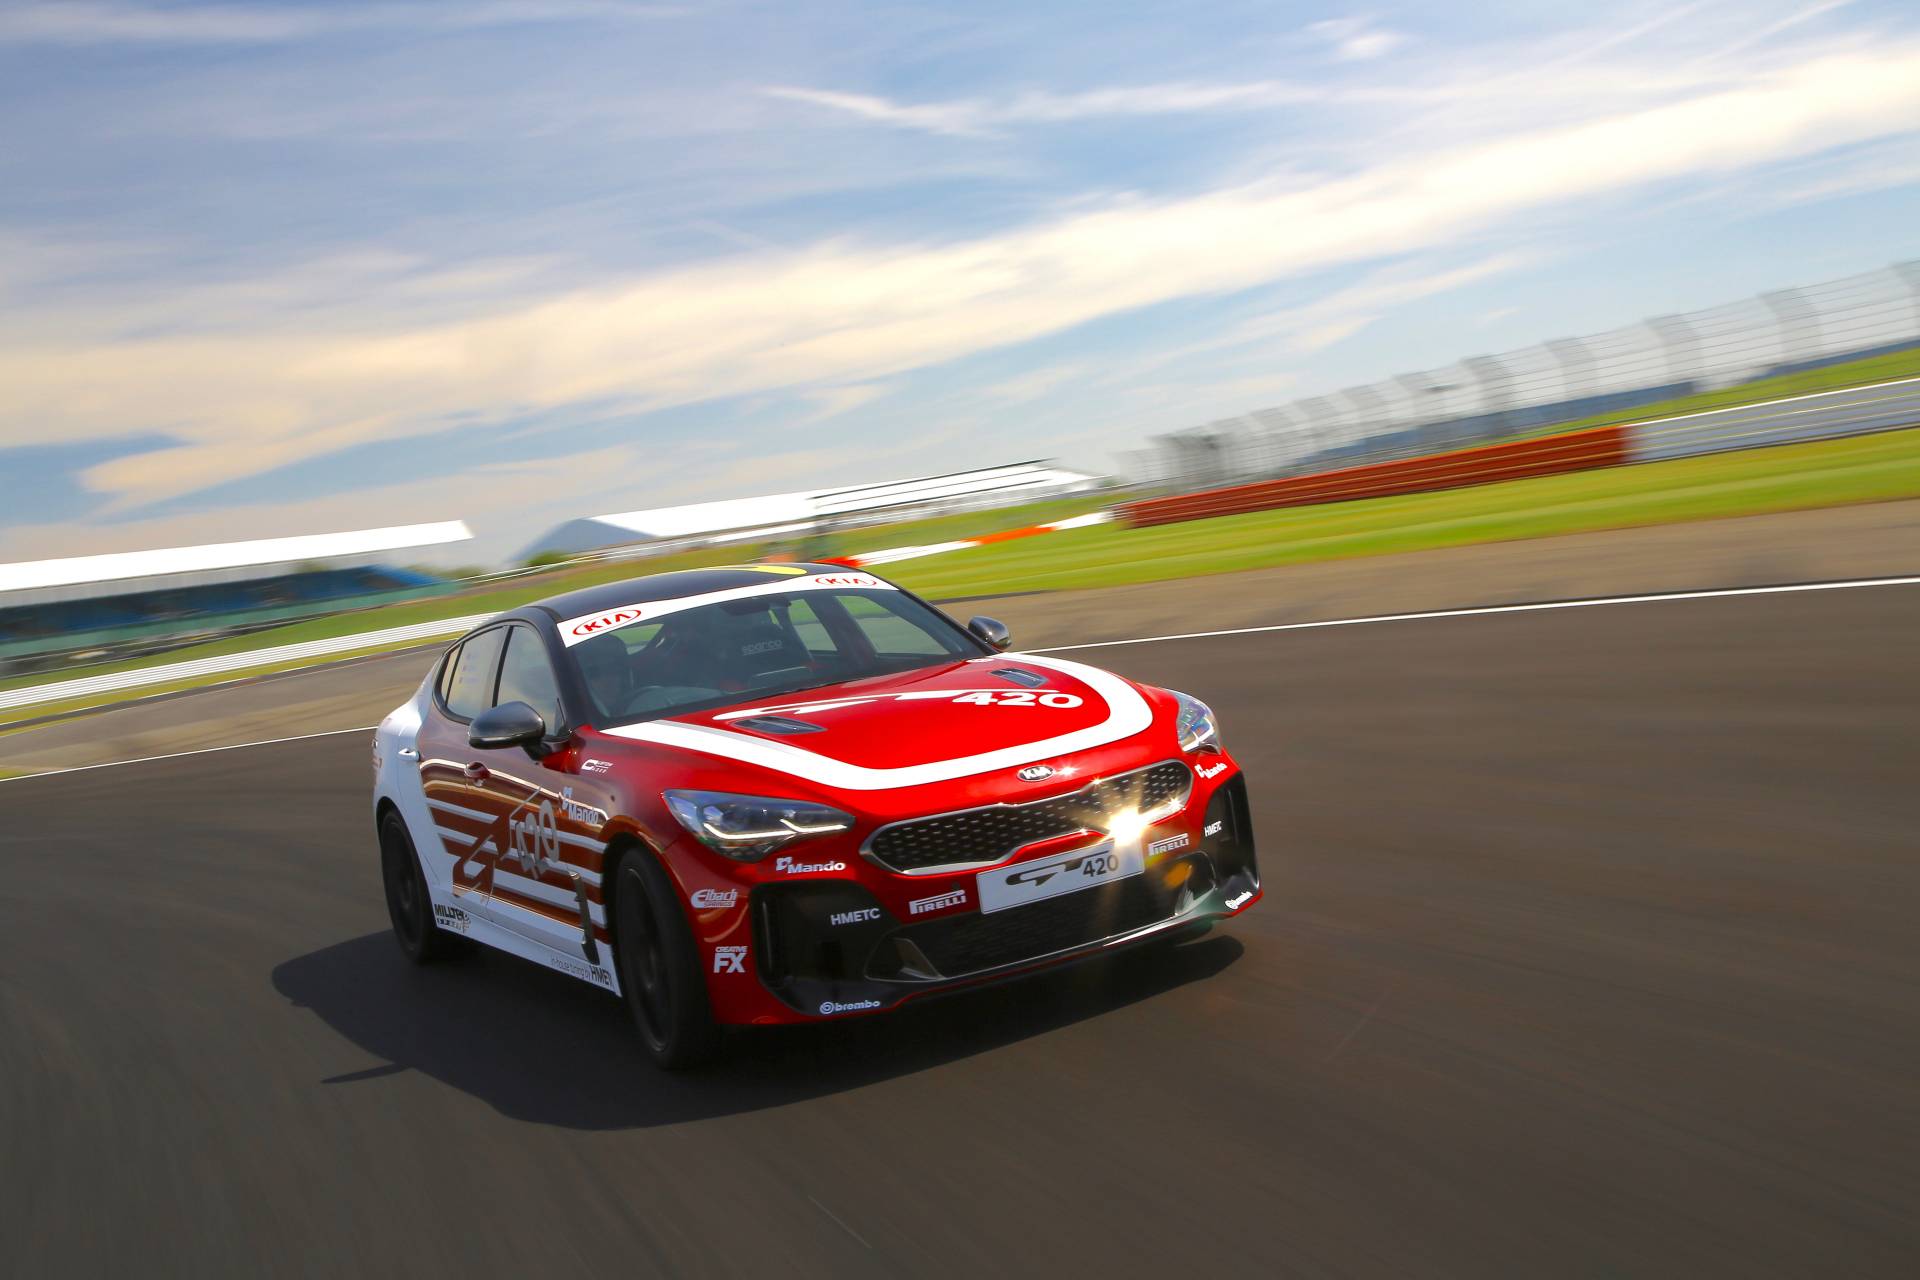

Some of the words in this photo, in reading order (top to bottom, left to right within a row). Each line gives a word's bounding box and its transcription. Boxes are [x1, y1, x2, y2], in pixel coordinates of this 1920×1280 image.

[583, 612, 632, 632] KIA
[952, 691, 1084, 709] 420
[1021, 765, 1053, 781] KIA
[568, 802, 599, 825] Mando
[1148, 832, 1190, 857] PIRELLI
[788, 861, 846, 874] Mando
[1082, 854, 1119, 878] 420
[690, 888, 738, 909] Eibach
[909, 889, 967, 914] PIRELLI
[830, 908, 881, 926] HMETC
[713, 952, 747, 974] FX
[834, 999, 881, 1012] brembo
